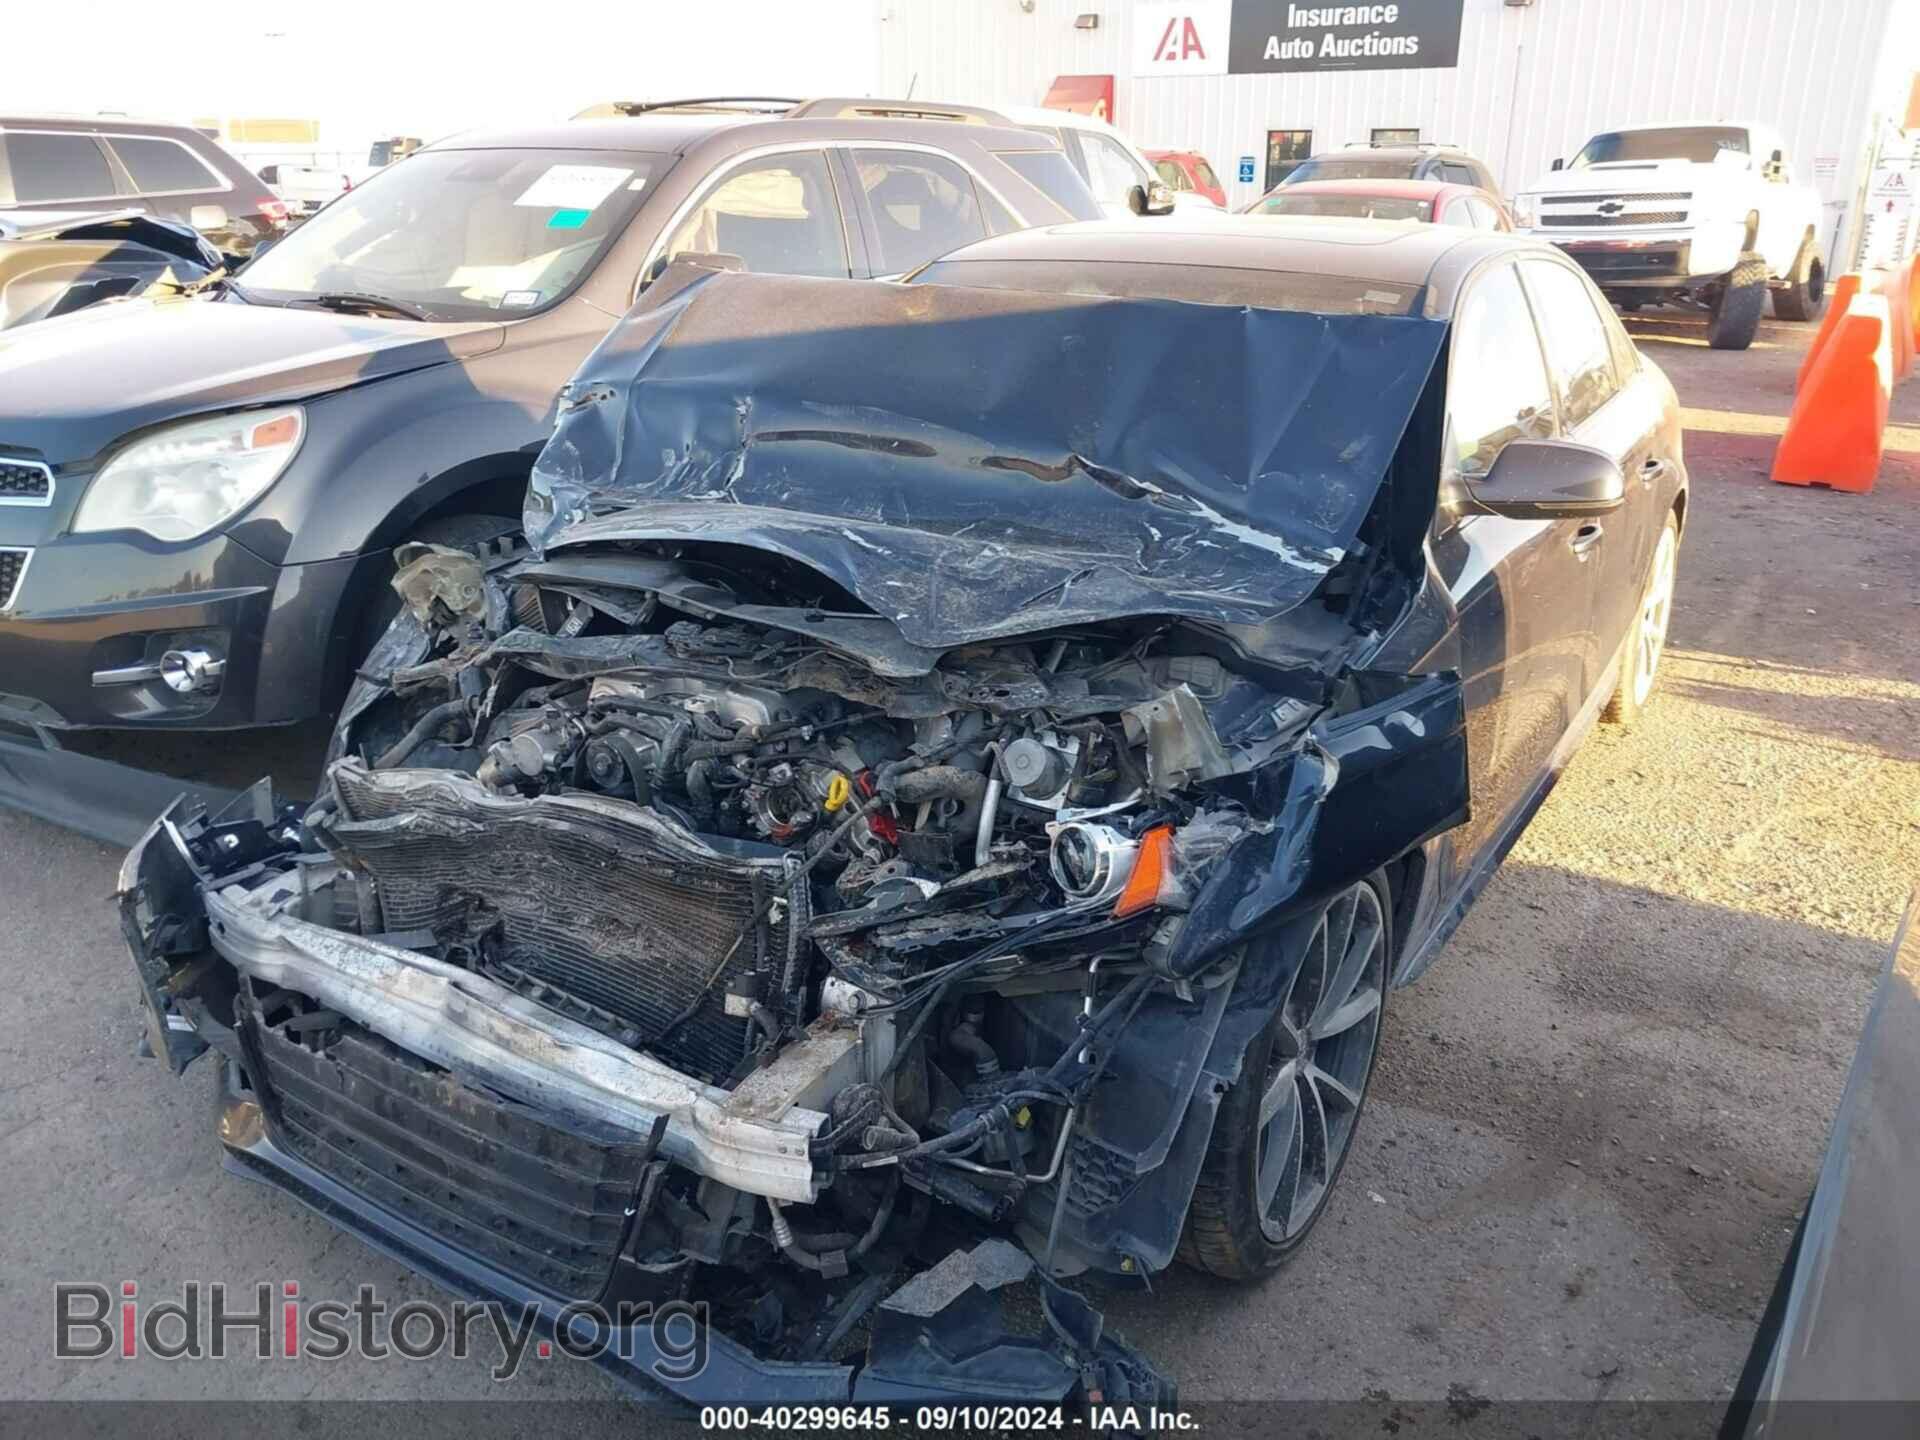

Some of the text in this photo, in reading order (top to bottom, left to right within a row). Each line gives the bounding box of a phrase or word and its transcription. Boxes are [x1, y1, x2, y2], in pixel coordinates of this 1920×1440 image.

[1287, 3, 1400, 28] Insurance
[1263, 32, 1419, 60] Auto Auctions
